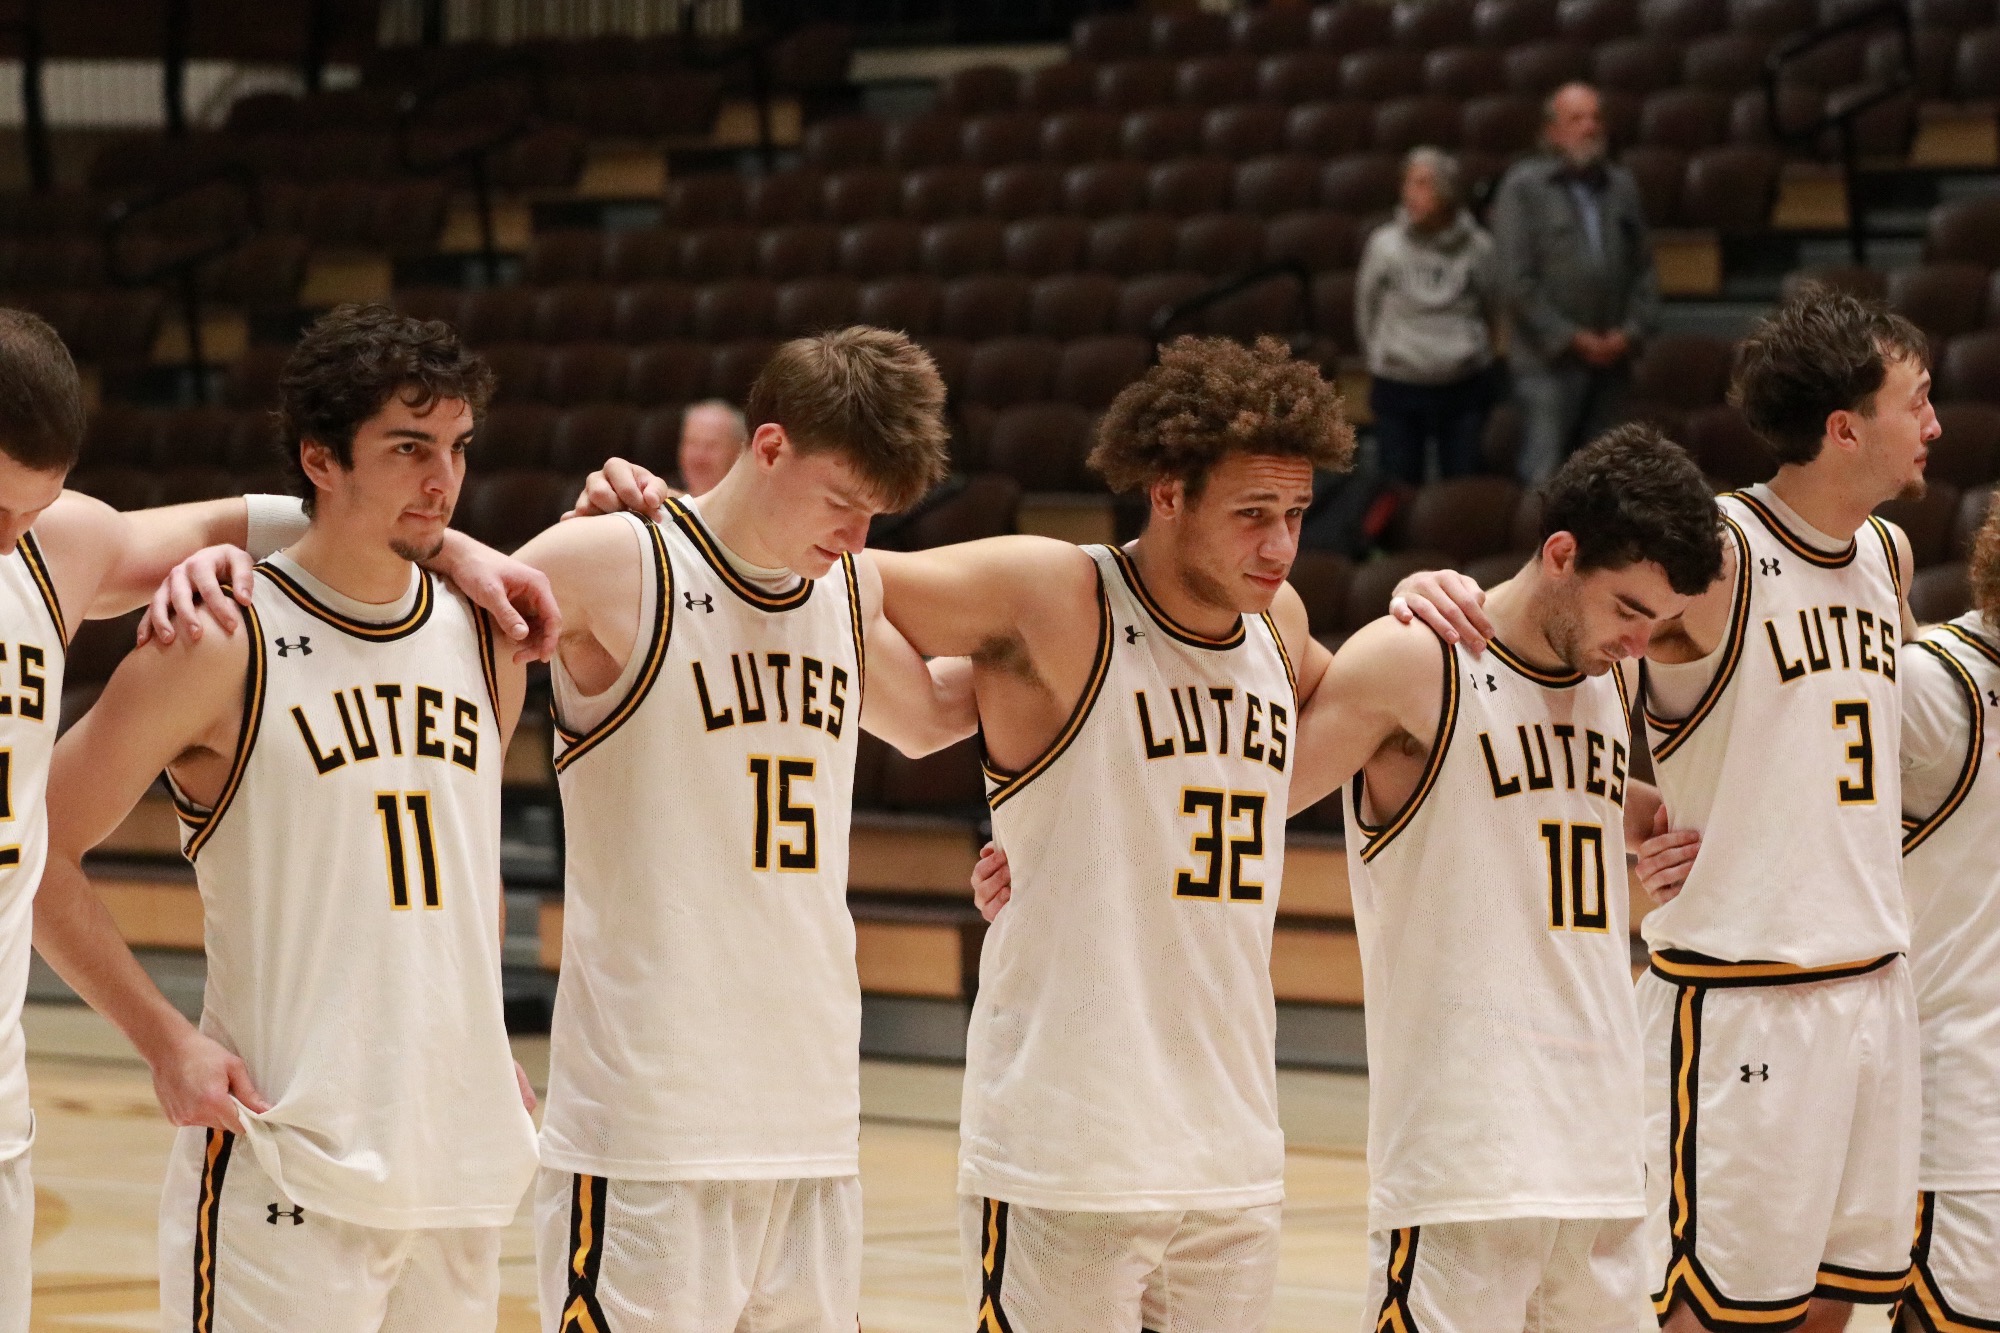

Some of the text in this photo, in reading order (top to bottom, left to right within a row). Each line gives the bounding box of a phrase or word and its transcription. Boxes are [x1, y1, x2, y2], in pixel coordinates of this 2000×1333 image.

[1764, 605, 1896, 685] LUTES
[288, 683, 480, 776] LUTES
[691, 651, 849, 742] LUTES
[1134, 686, 1288, 775] LUTES
[1478, 723, 1627, 811] LUTES
[1832, 699, 1877, 806] 3
[374, 790, 443, 910] 11
[747, 754, 819, 873] 15
[1172, 785, 1268, 904] 32
[1538, 819, 1609, 934] 10
